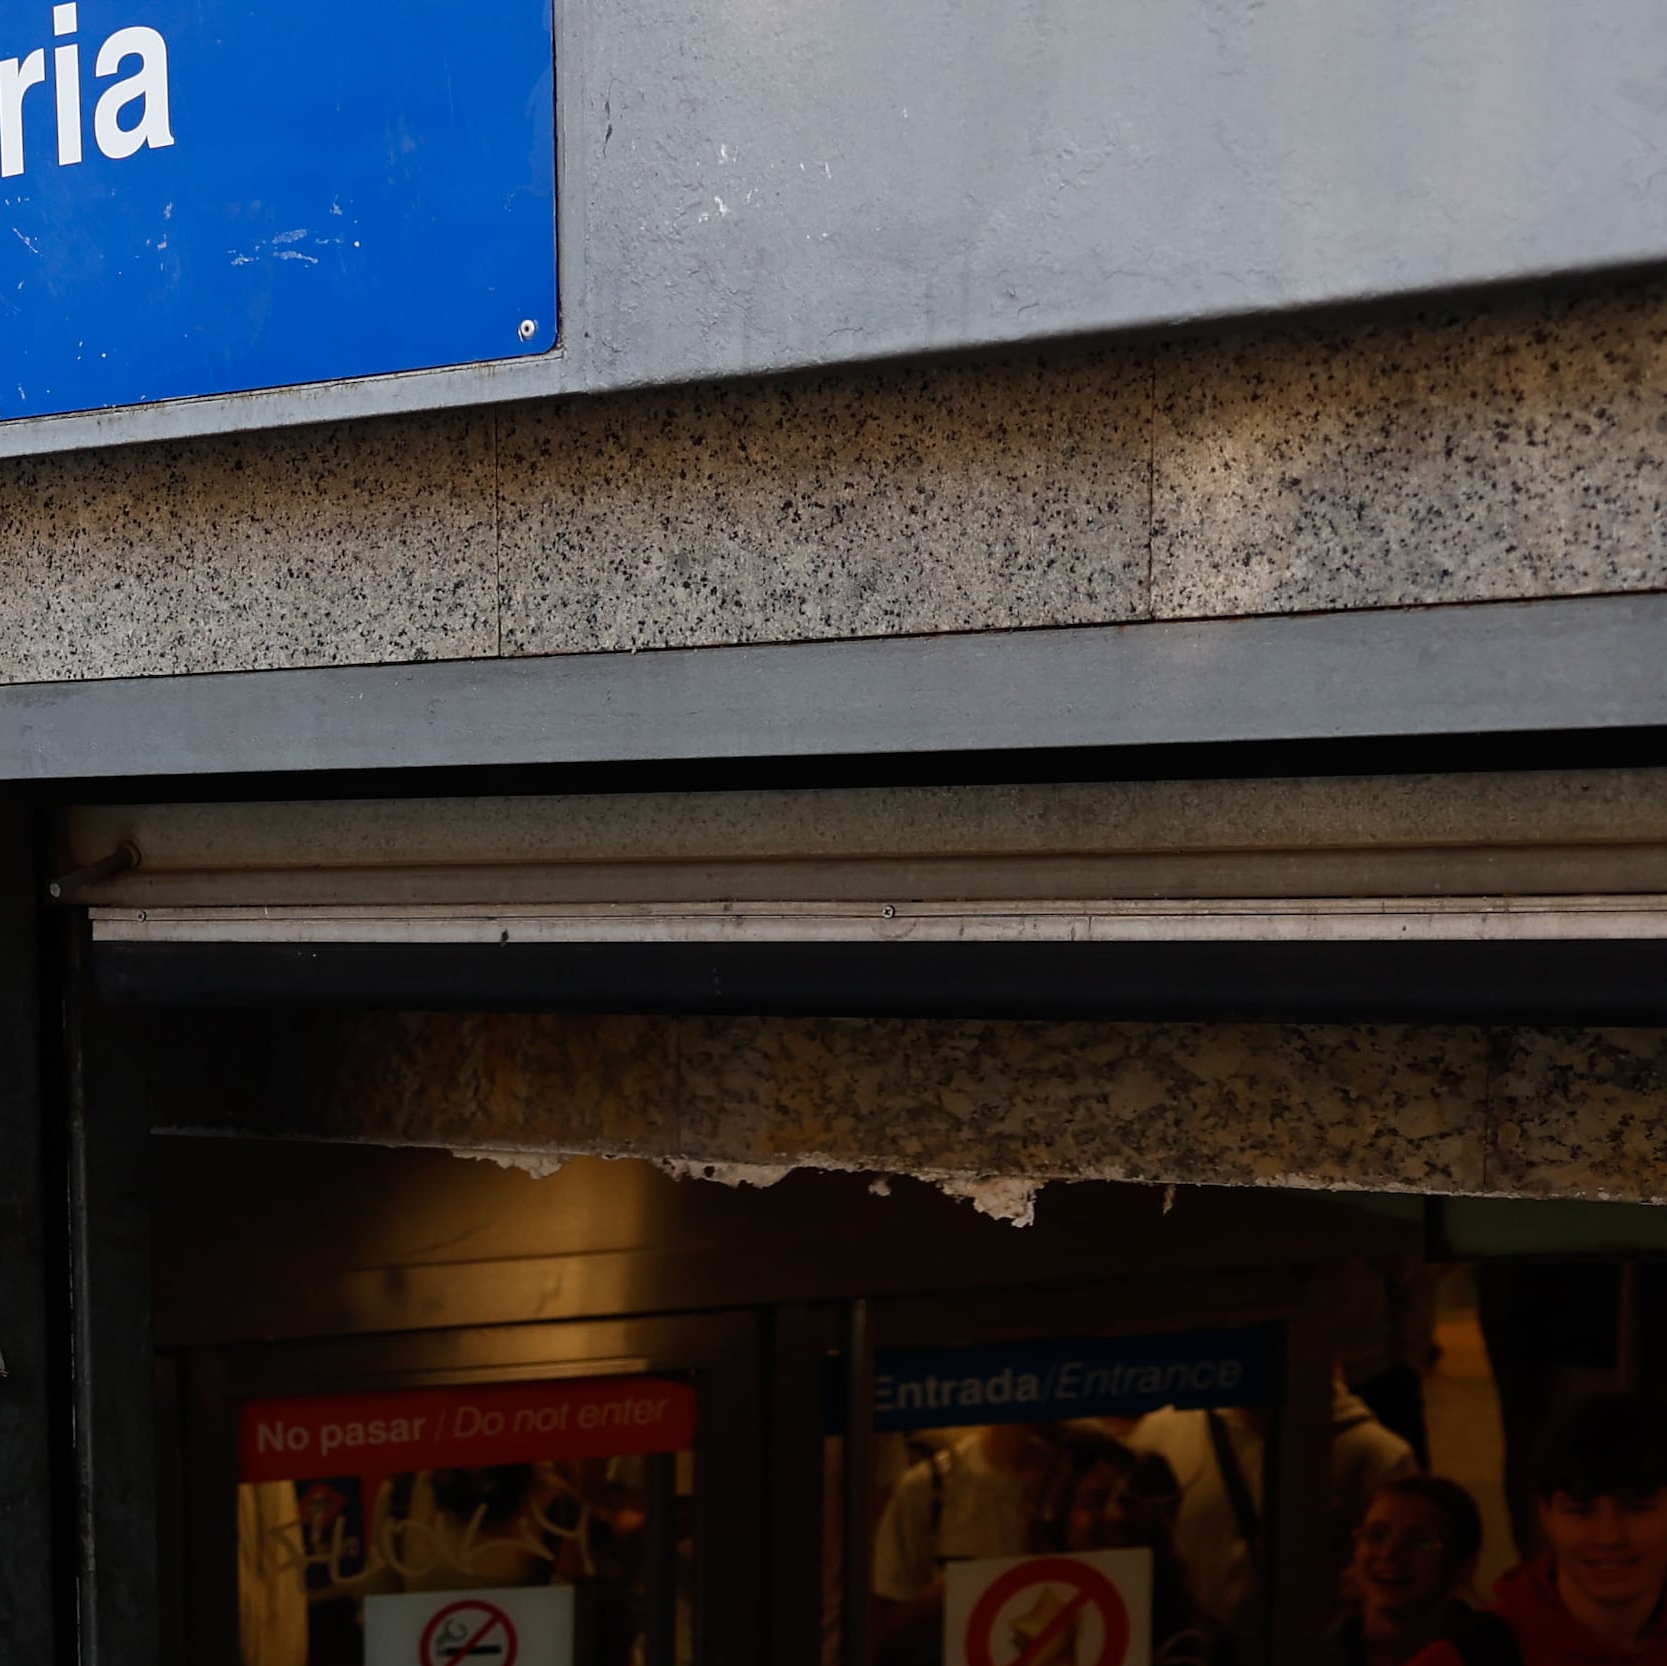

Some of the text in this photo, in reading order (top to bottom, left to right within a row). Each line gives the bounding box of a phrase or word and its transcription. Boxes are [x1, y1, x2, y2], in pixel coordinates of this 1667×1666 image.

[256, 1418, 310, 1454] No
[320, 1415, 427, 1457] pasar
[453, 1406, 505, 1439] Do
[514, 1401, 571, 1435] not
[577, 1396, 670, 1430] enter
